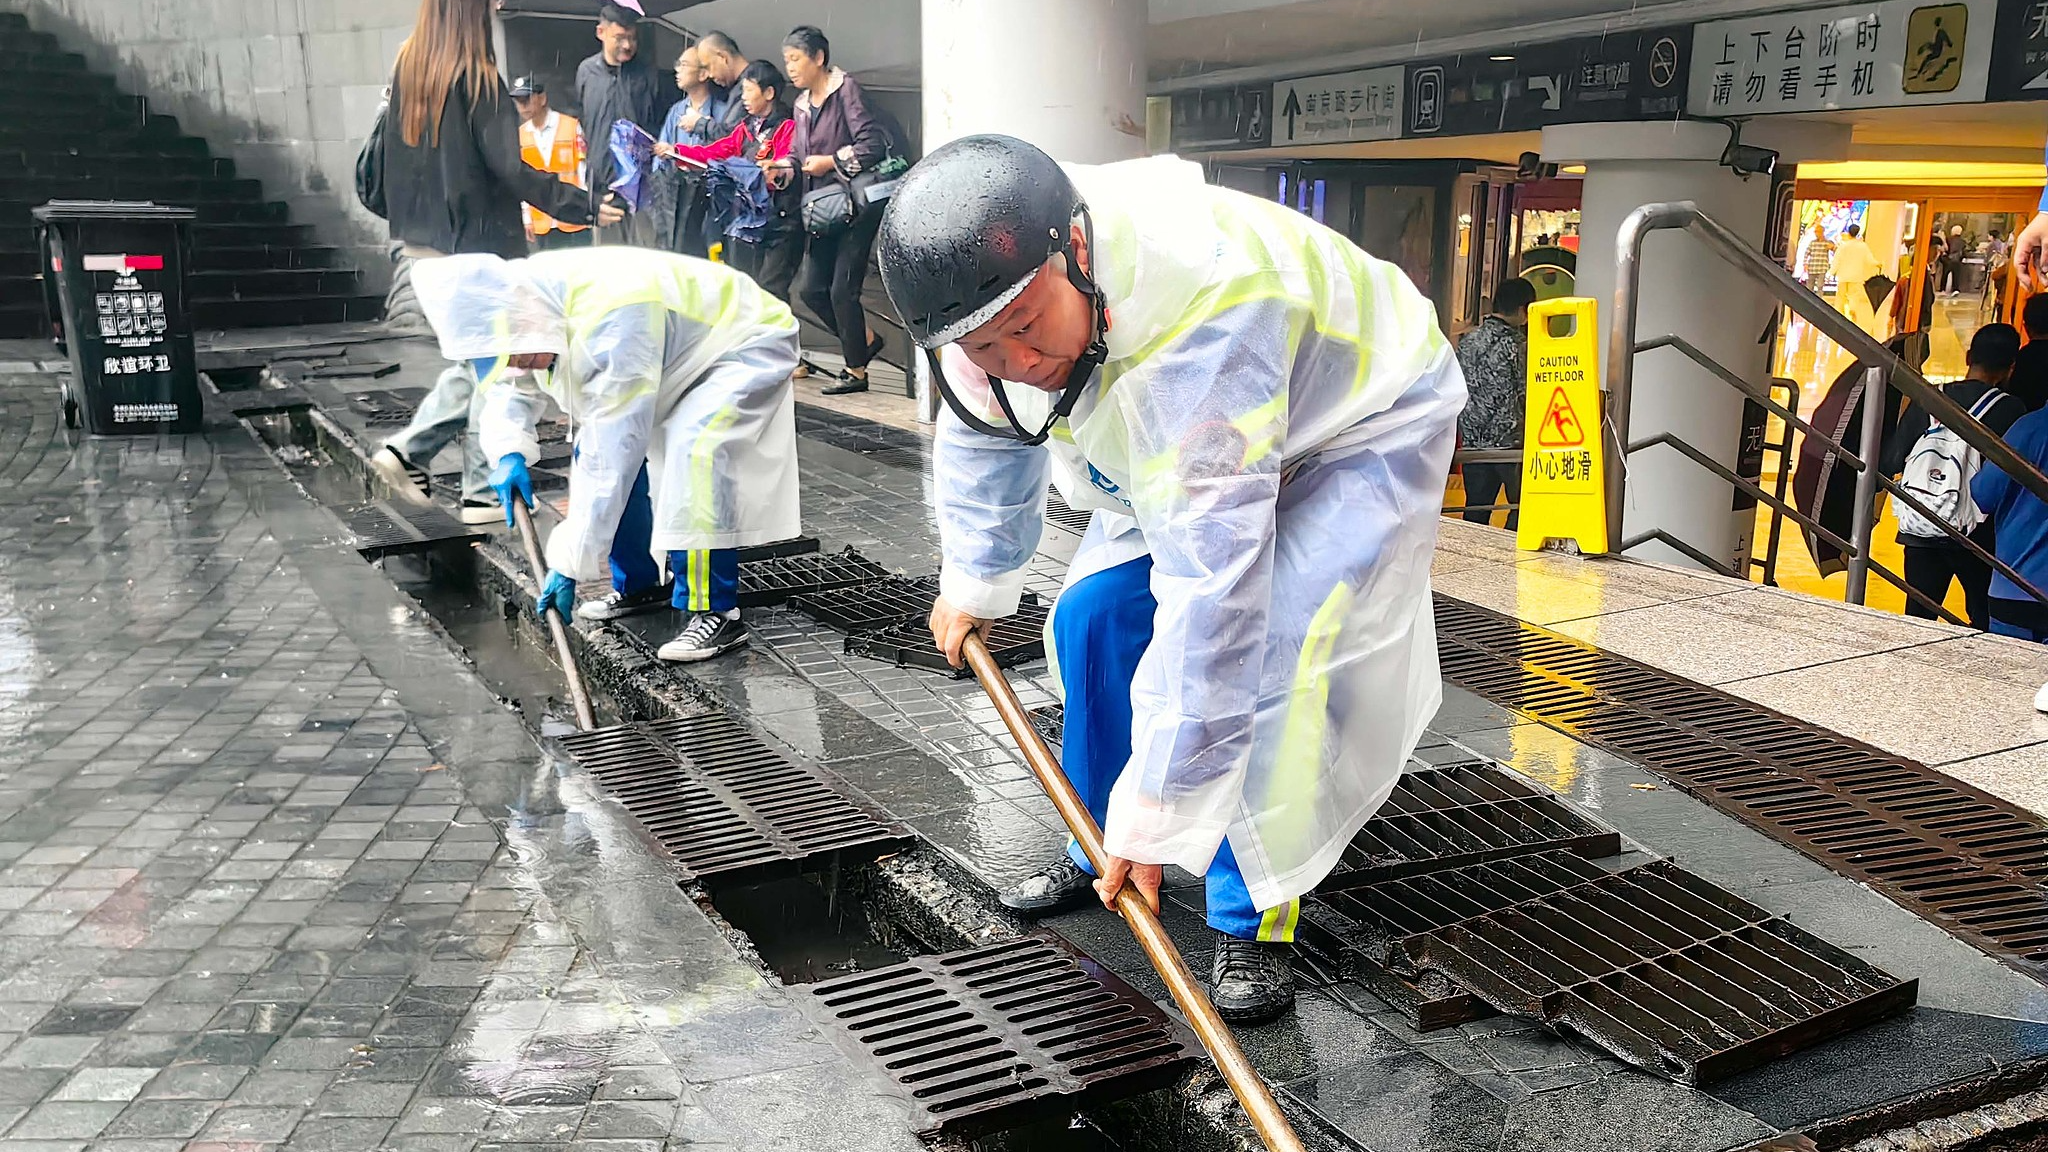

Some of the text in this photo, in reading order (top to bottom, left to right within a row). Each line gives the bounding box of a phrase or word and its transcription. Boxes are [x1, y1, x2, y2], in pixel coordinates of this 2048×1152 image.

[1715, 20, 1882, 65] 上下台阶时
[1713, 61, 1875, 106] 请勿看手机
[1534, 370, 1585, 383] WET FLOOR
[1539, 354, 1579, 368] CAUTION
[1529, 450, 1592, 481] 小心地滑
